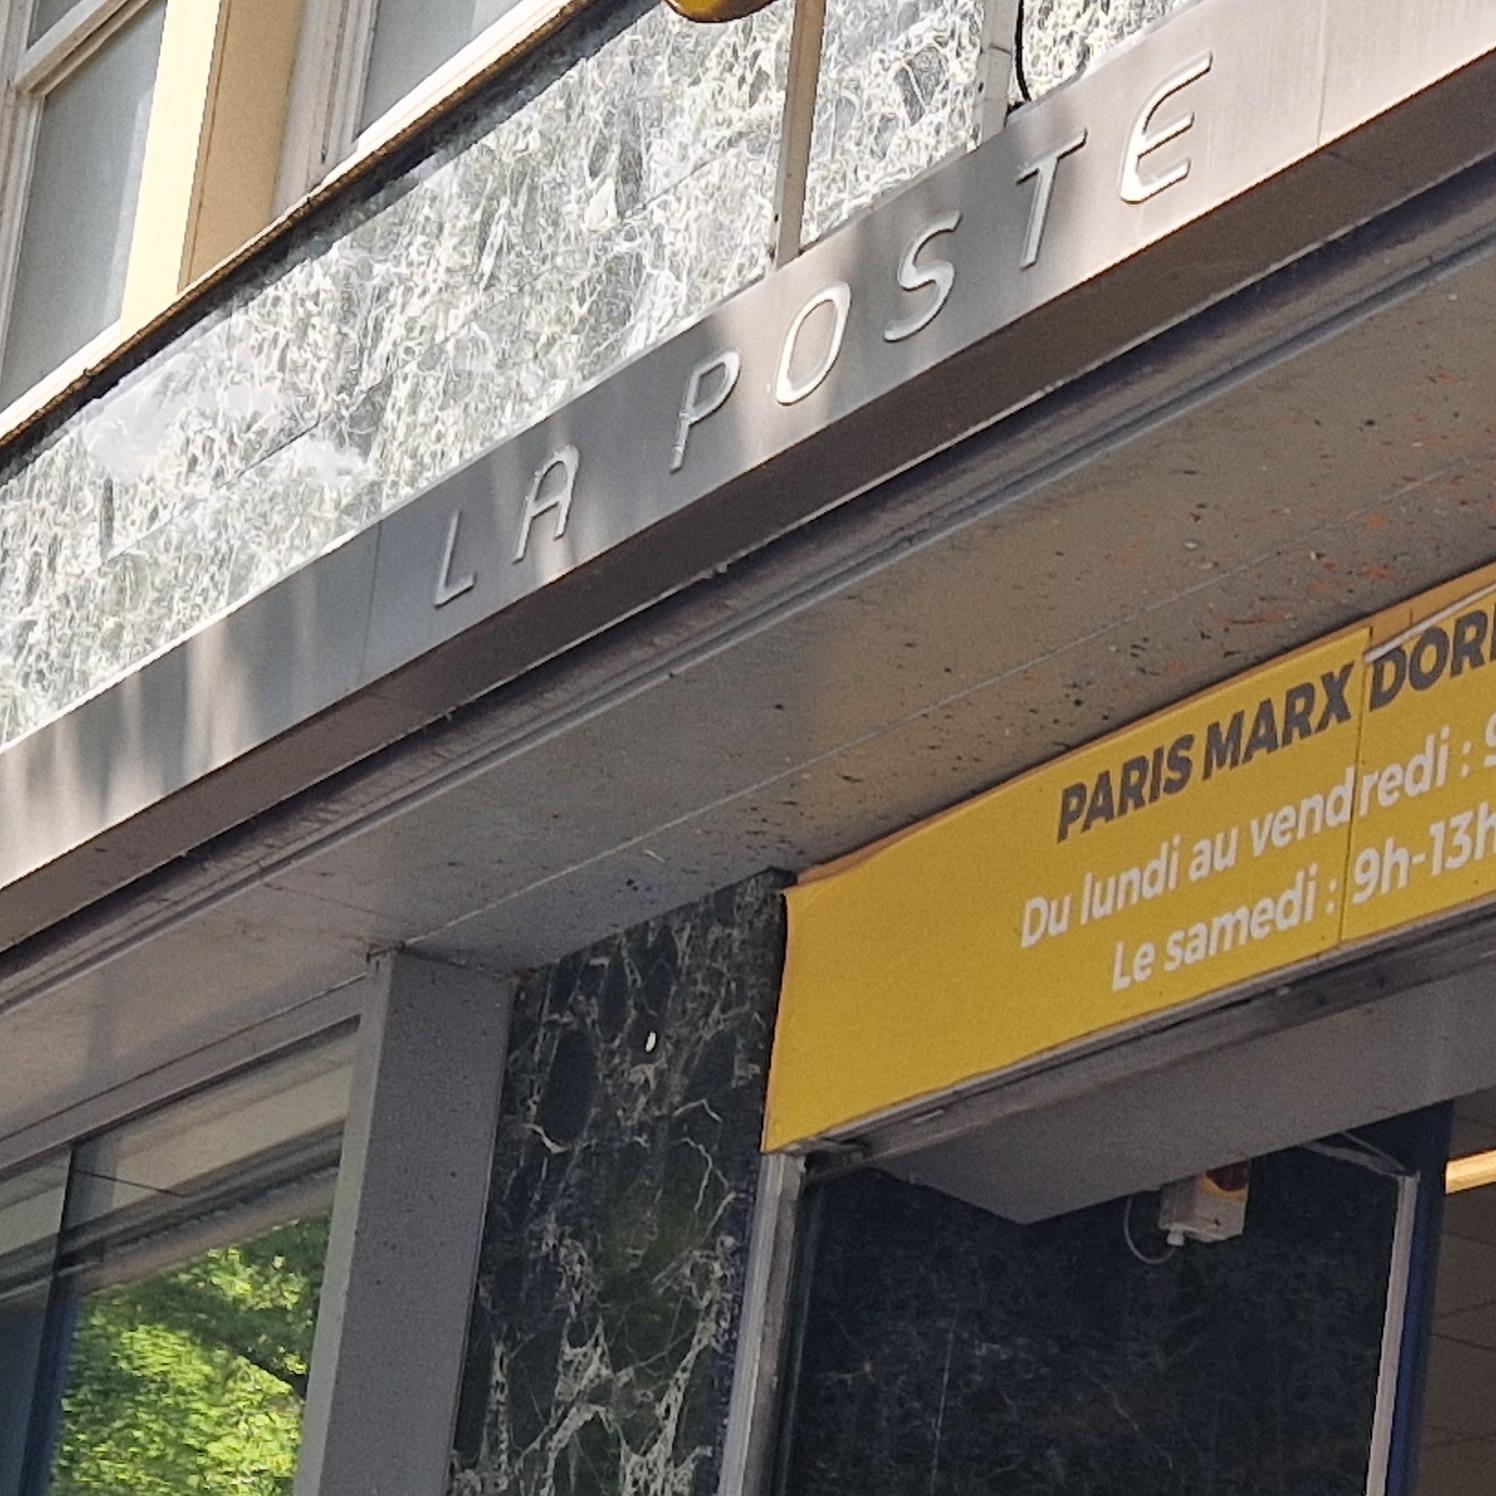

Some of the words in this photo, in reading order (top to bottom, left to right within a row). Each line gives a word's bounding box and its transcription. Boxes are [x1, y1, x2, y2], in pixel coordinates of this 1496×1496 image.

[434, 445, 581, 607] LA
[670, 50, 1213, 474] POSTE
[1020, 895, 1072, 948] Du
[1081, 836, 1179, 925] lundi
[1188, 828, 1237, 879] au
[1251, 727, 1449, 855] vendredi
[1058, 733, 1194, 842] PARIS
[1203, 662, 1355, 782] MARX
[1112, 942, 1153, 991] Le
[1164, 865, 1317, 971] samedi
